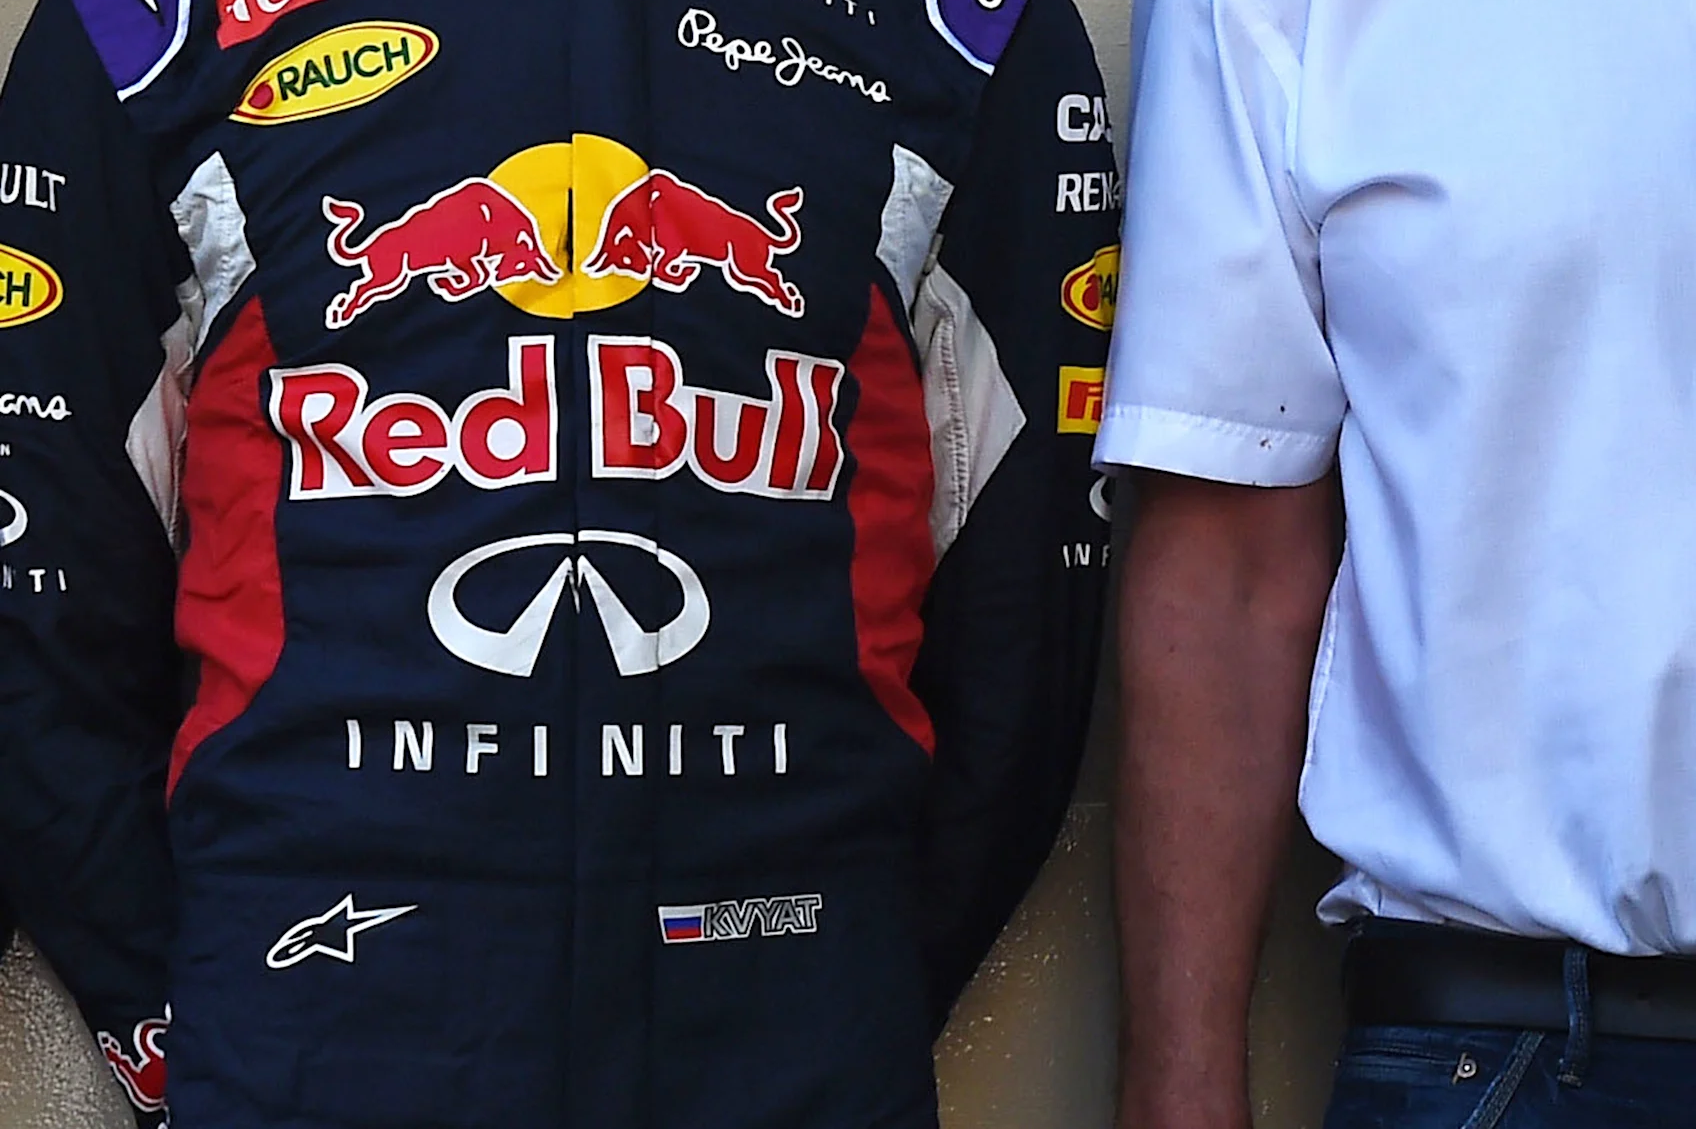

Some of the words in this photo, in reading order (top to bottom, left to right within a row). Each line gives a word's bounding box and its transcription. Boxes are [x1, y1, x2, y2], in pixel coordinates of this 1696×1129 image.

[277, 37, 410, 101] RAUCH
[678, 8, 776, 71] Pepe
[775, 37, 892, 102] Jeans
[269, 335, 559, 500] Red
[587, 335, 845, 500] Bull
[347, 720, 787, 775] INFINITI
[702, 893, 822, 941] KVYAT
